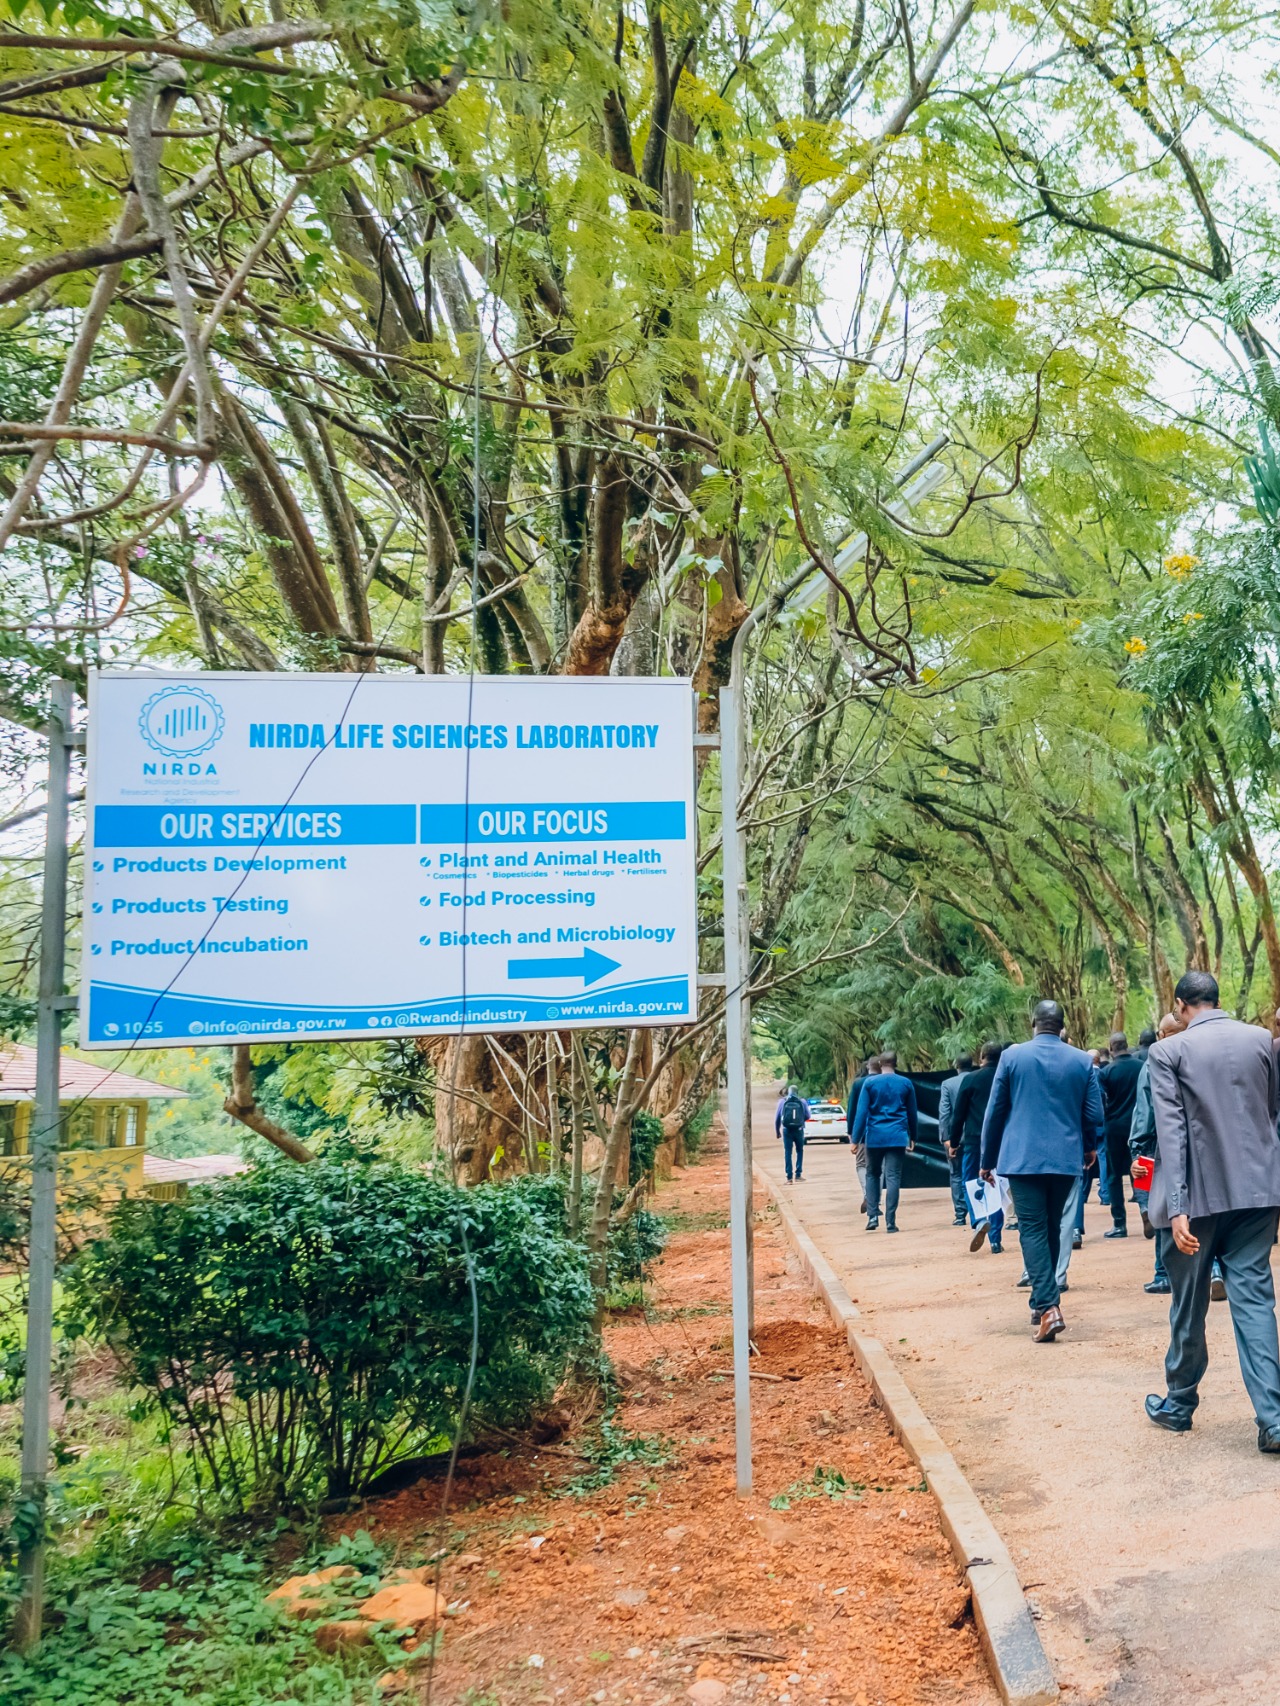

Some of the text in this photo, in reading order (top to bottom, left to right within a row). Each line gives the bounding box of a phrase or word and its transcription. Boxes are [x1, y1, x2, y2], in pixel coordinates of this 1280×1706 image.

[250, 723, 659, 749] NIRDA LIFE SCIENCES LABORATORY
[143, 762, 217, 776] NIRDA
[144, 778, 220, 786] National Industrial
[120, 788, 240, 797] Research and Development
[164, 797, 197, 805] Agency
[160, 812, 342, 839] OUR SERVICES
[478, 809, 608, 836] OUR FOCUS
[113, 856, 347, 874] Products Development
[439, 849, 661, 868] Plant and Animal Health
[432, 867, 667, 880] Cosmetics Biopesticides Herbal drugs Fertilisers
[112, 896, 289, 915] Products Testing
[439, 889, 596, 907] Food Processing
[439, 925, 676, 946] Biotech and Microbiology
[110, 936, 308, 956] Product Incubation
[561, 1001, 684, 1016] www.nirda.gov.rw
[124, 1021, 163, 1034] 1055
[394, 1009, 528, 1028] @Rwandaindustry
